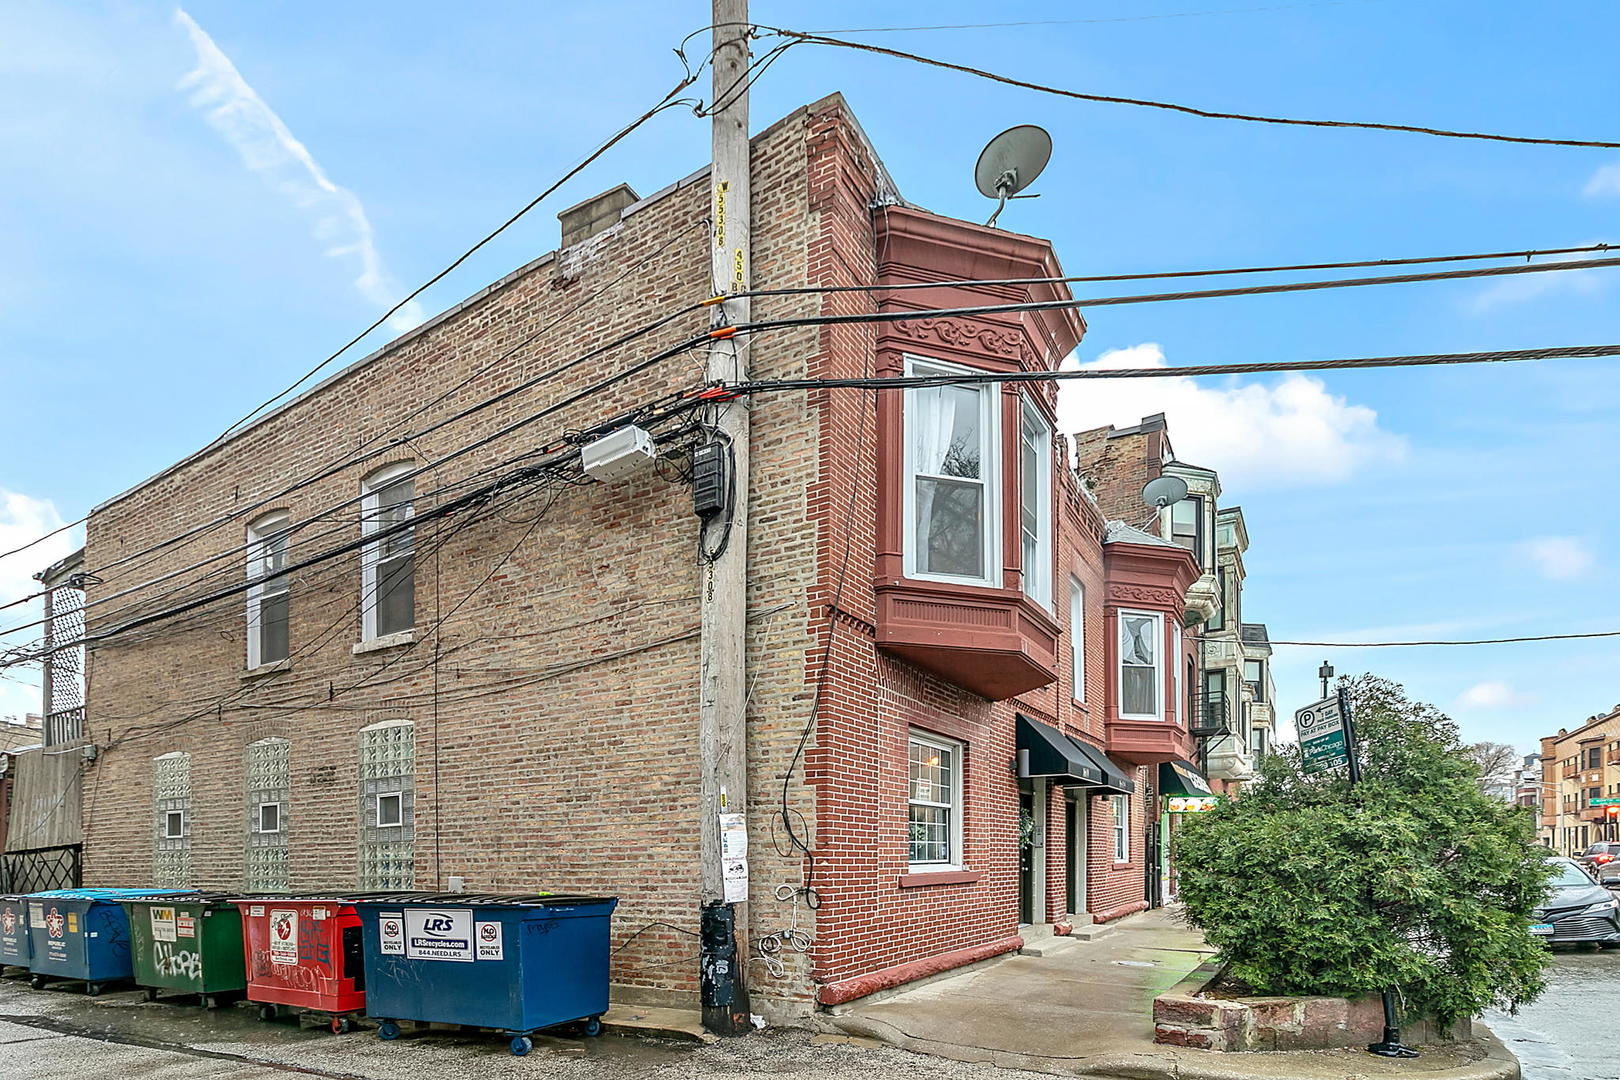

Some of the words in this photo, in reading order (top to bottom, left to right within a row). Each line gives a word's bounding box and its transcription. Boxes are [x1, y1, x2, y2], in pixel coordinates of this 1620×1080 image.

[1317, 724, 1327, 732] PAY
[1328, 720, 1340, 728] BOX
[152, 909, 173, 921] WM
[423, 919, 454, 931] LRS
[414, 939, 465, 949] LRSrecycles.com
